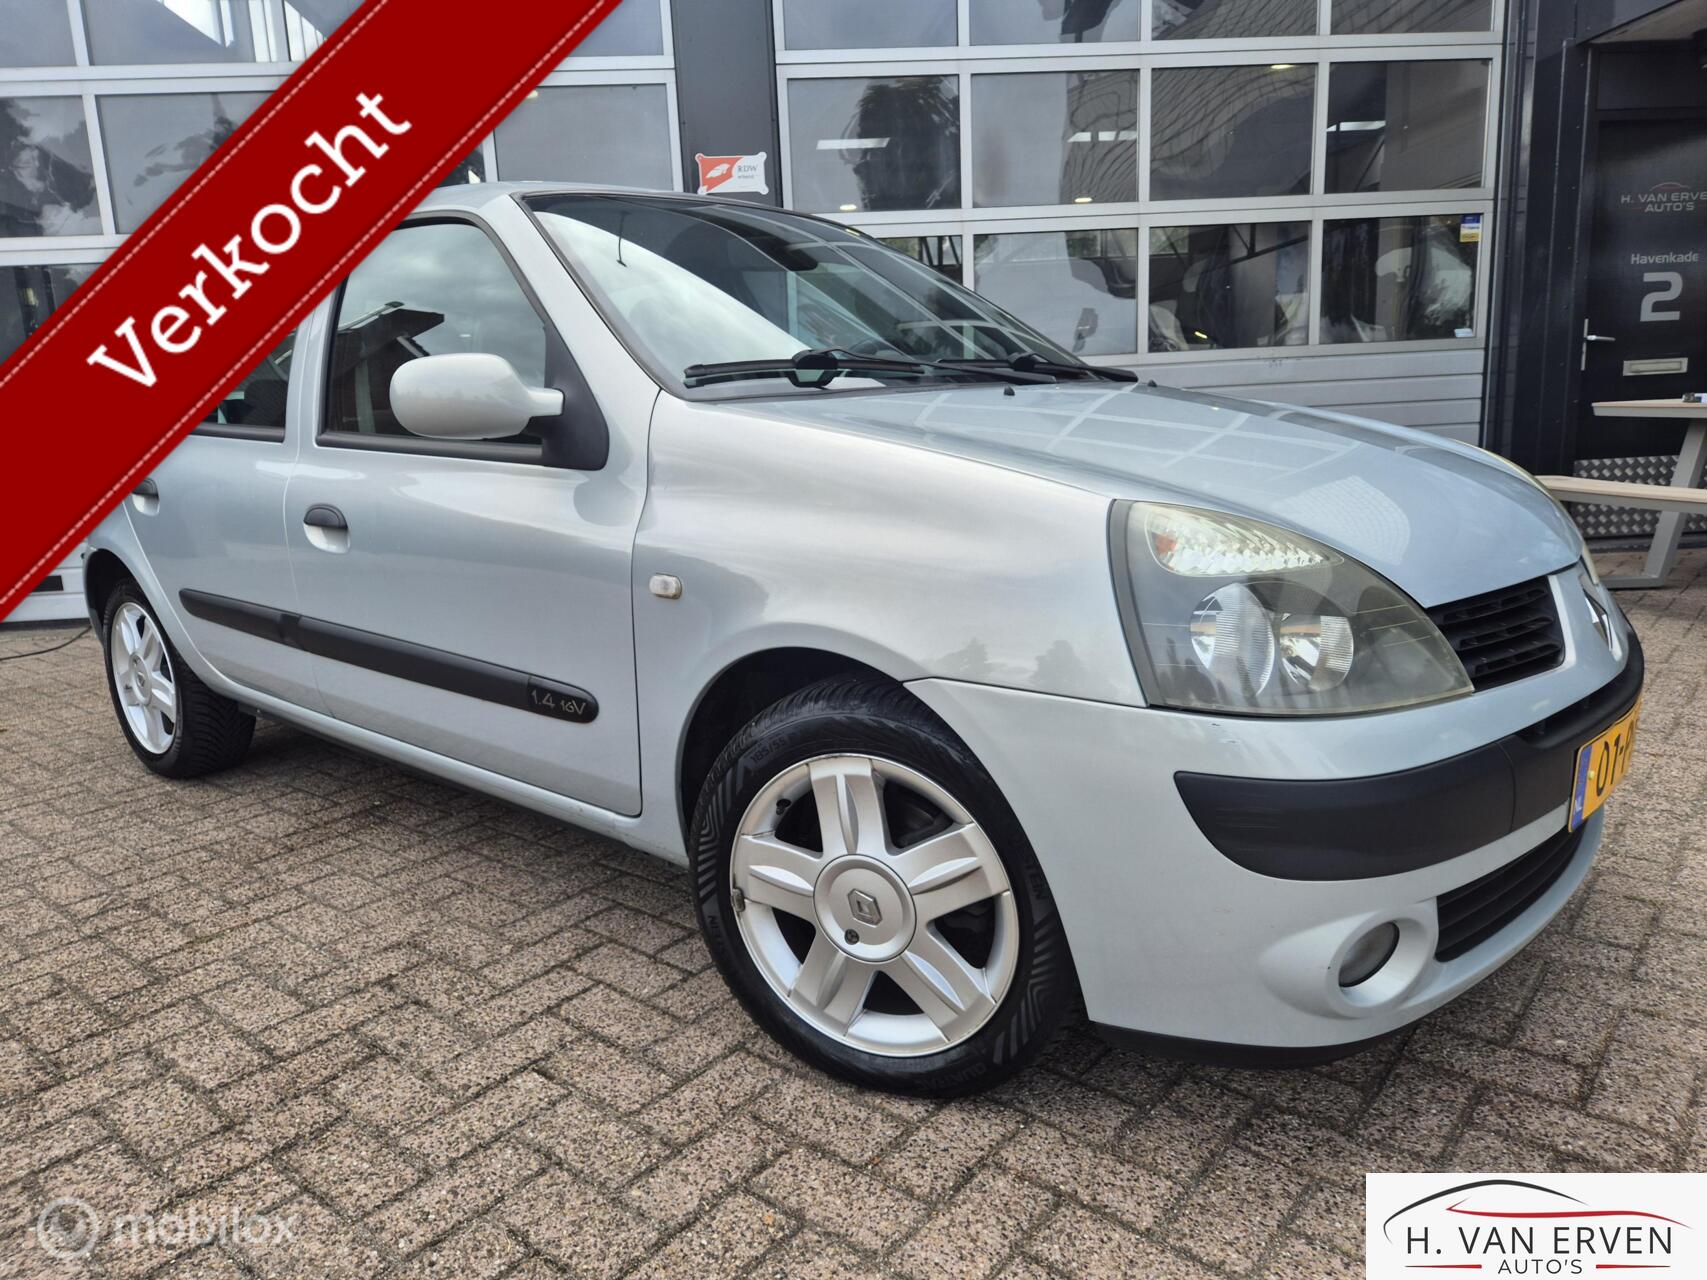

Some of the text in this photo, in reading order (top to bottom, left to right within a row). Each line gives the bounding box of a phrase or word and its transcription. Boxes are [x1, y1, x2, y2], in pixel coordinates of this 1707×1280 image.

[738, 164, 758, 173] RDW
[1620, 194, 1635, 204] H.
[1638, 192, 1668, 203] VAN
[1644, 202, 1695, 213] AUTO'S
[1630, 251, 1699, 265] Havenkade
[1640, 271, 1683, 322] 2
[531, 689, 586, 715] 1.4 16V
[1596, 719, 1635, 797] 01-P
